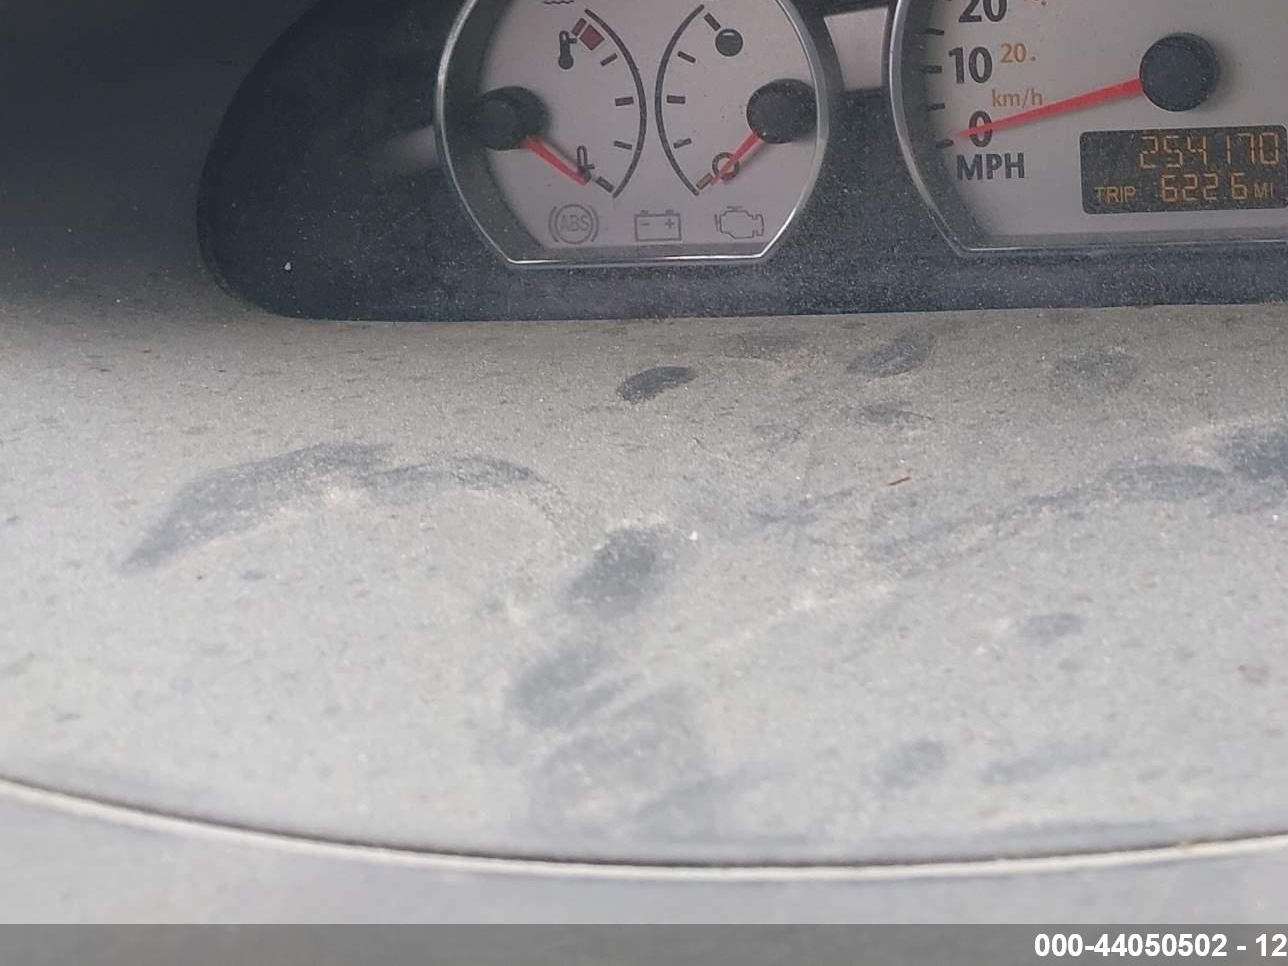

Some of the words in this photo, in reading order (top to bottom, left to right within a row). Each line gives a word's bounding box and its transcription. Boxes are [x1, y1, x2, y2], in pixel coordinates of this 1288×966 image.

[948, 46, 993, 84] 10
[1000, 43, 1027, 63] 20
[991, 88, 1043, 107] km/h
[969, 110, 993, 148] 0
[1138, 132, 1280, 170] 254170
[956, 153, 1025, 180] MPH
[1094, 185, 1137, 203] TRIP
[1254, 183, 1274, 199] MI
